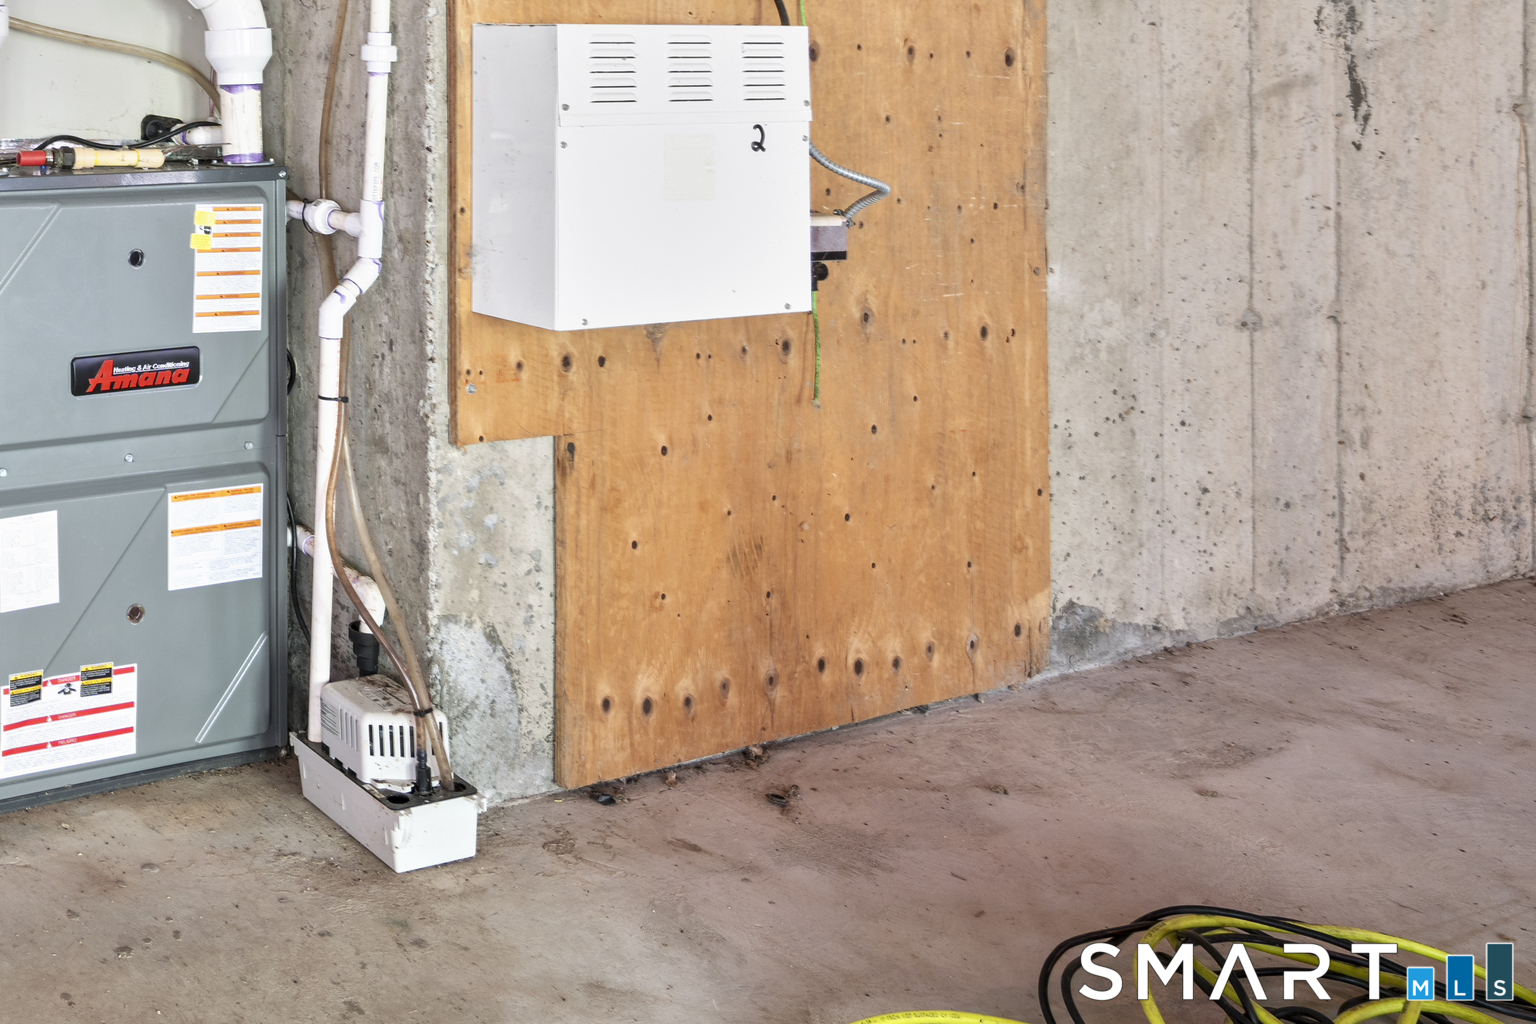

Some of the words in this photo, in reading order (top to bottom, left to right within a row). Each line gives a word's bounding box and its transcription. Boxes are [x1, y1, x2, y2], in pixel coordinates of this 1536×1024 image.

[750, 124, 766, 153] 2
[86, 359, 190, 393] Amana
[153, 361, 190, 369] Conditioning
